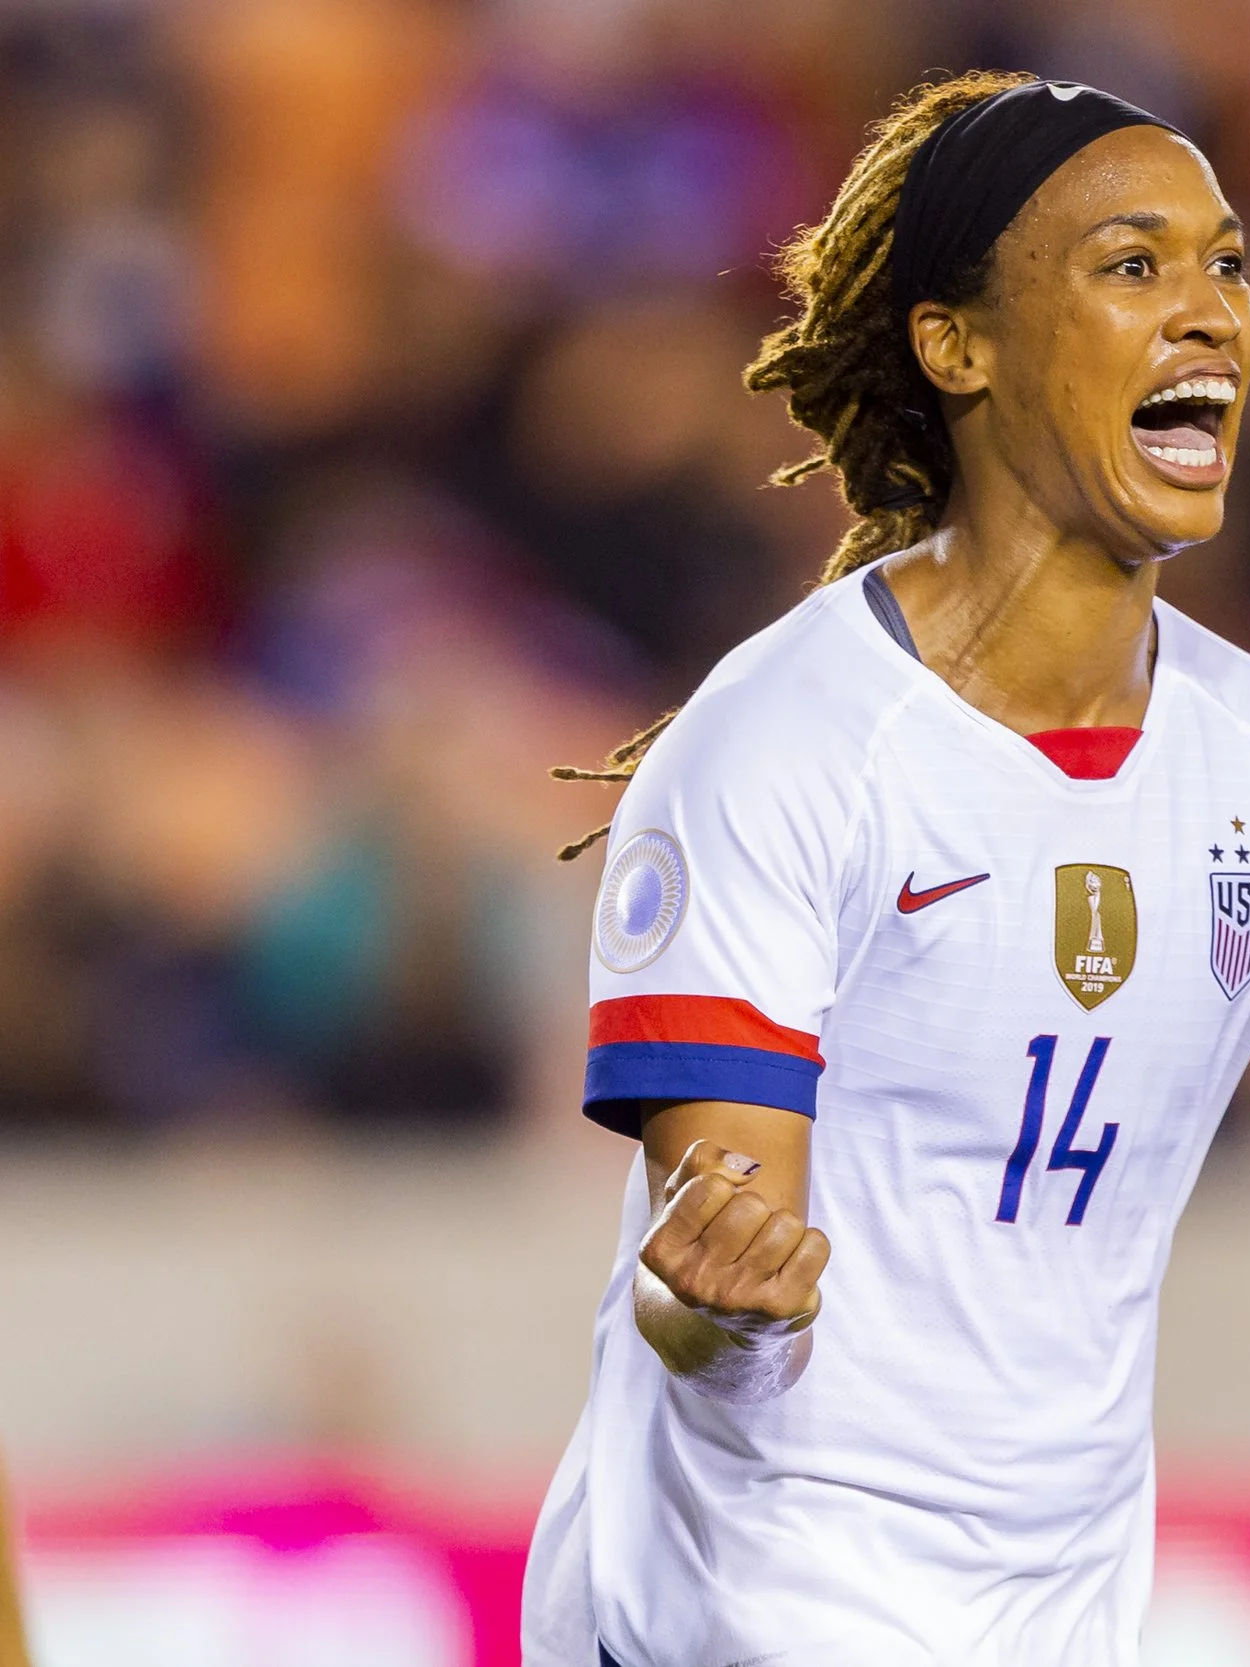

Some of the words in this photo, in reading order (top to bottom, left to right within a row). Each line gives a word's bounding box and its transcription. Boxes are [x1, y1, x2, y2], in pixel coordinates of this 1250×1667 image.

[1075, 955, 1114, 975] FIFA
[1081, 981, 1105, 993] 2019
[995, 1034, 1121, 1226] 14
